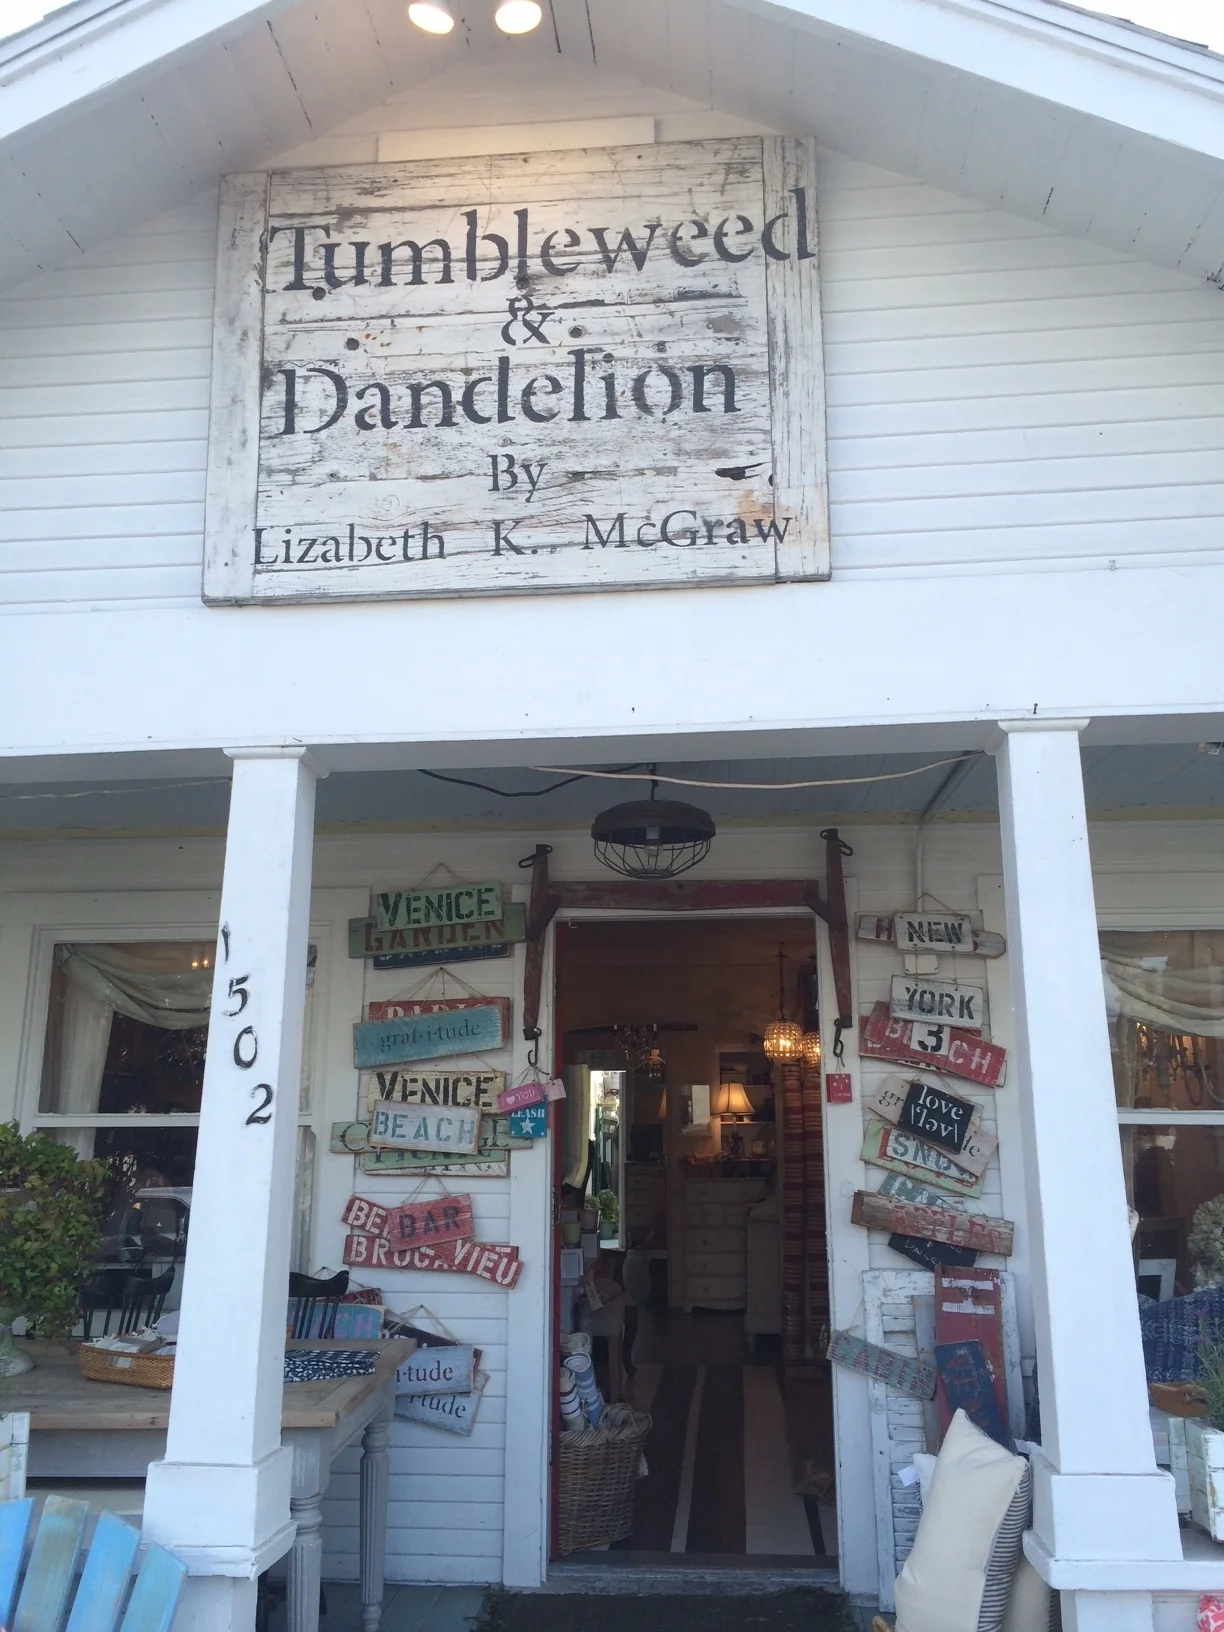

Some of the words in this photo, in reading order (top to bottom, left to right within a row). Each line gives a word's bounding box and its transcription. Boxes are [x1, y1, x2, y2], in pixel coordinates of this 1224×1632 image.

[266, 187, 816, 292] Tumbleweed
[501, 295, 555, 346] &
[275, 348, 741, 436] Dandelion
[487, 453, 548, 502] By
[253, 521, 446, 566] Lizabeth
[581, 508, 793, 551] McGraw
[380, 887, 495, 927] VENICE
[907, 920, 963, 944] NEW
[221, 920, 274, 1126] 1502
[905, 986, 975, 1020] YORK
[376, 1071, 497, 1107] VENICE
[917, 1086, 964, 1120] love
[373, 1111, 476, 1150] BEACH
[398, 1205, 460, 1239] BAR
